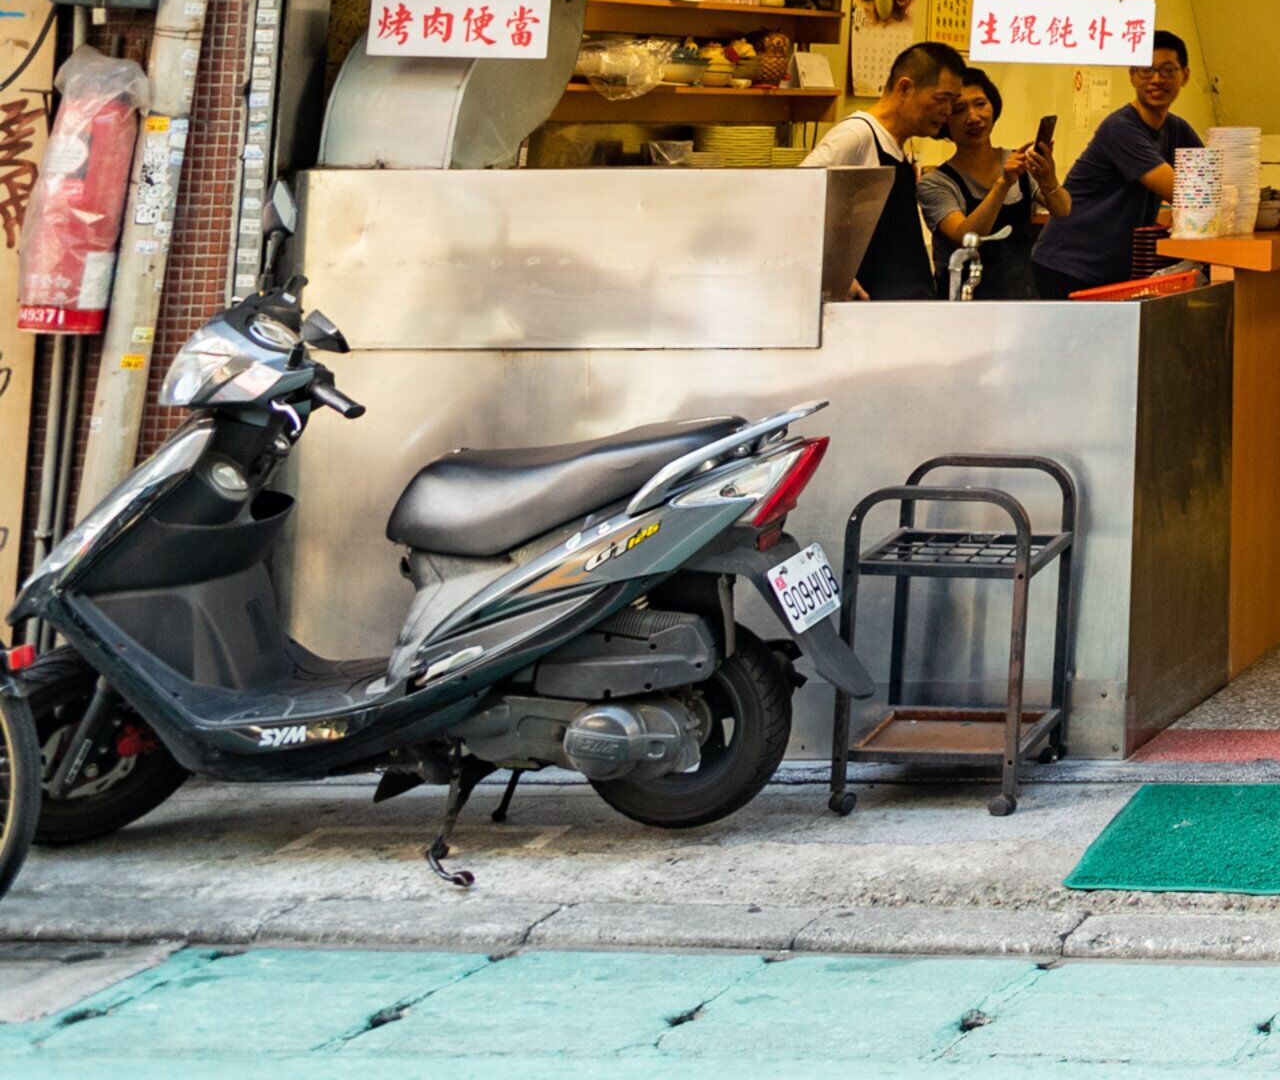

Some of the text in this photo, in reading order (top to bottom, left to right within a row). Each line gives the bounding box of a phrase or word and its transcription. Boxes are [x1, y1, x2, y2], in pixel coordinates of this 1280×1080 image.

[377, 3, 541, 48] 烤肉便當
[977, 12, 1148, 54] 生餛飩外帶
[258, 726, 307, 748] SYM
